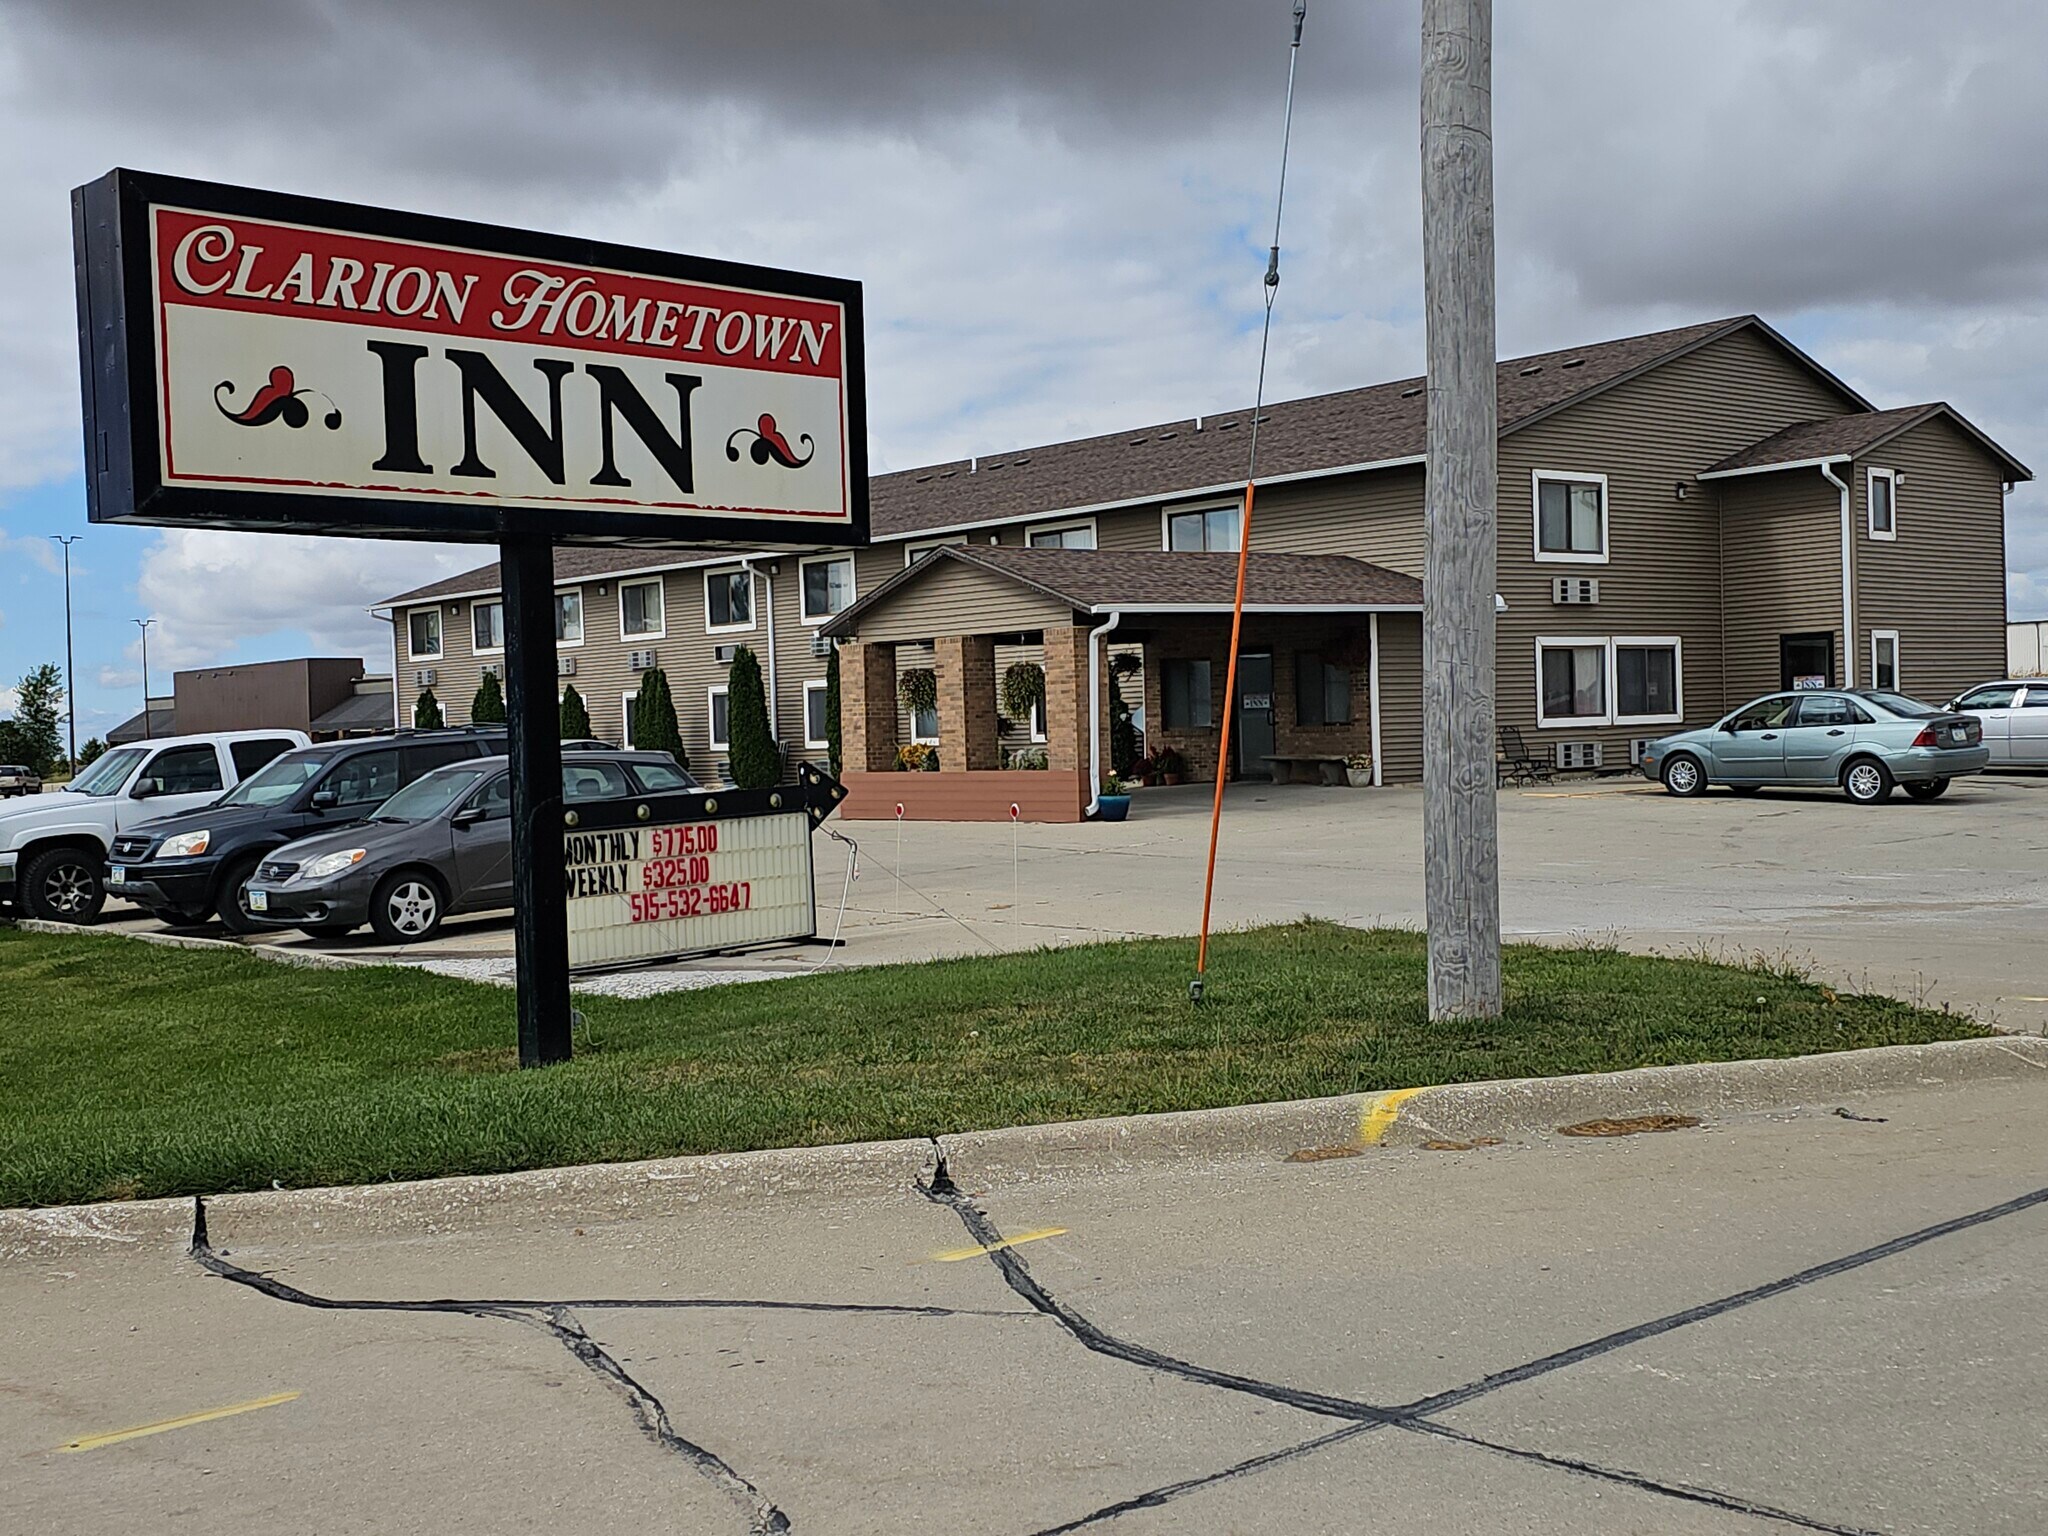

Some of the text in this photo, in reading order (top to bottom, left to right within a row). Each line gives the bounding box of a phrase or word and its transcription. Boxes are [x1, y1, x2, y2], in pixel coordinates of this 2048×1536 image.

[366, 339, 702, 494] INN
[652, 825, 718, 858] $775.00
[643, 856, 710, 890] $325.00
[630, 882, 750, 921] 515-532-6647
